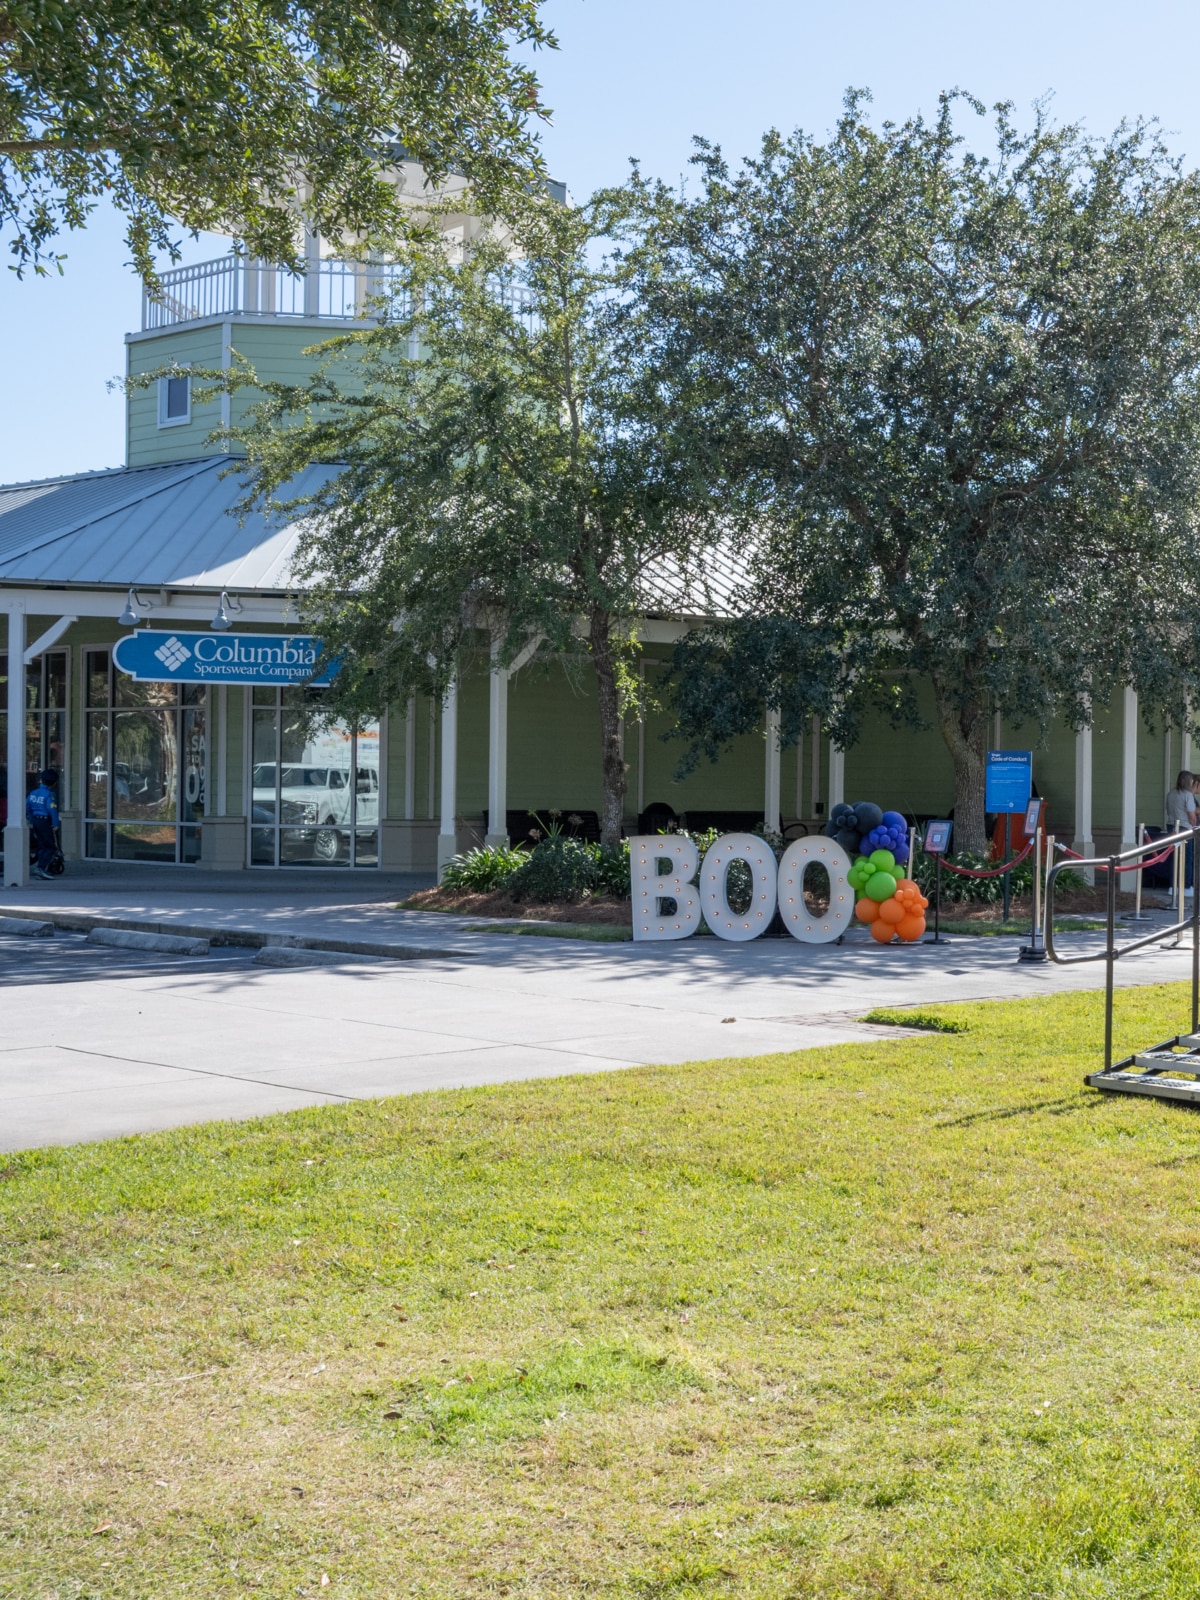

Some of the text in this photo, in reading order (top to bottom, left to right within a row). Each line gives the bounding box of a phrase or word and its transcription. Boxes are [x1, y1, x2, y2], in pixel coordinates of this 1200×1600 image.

[194, 637, 316, 665] Columbia
[193, 661, 259, 677] Sportswear
[629, 832, 856, 944] BOO
